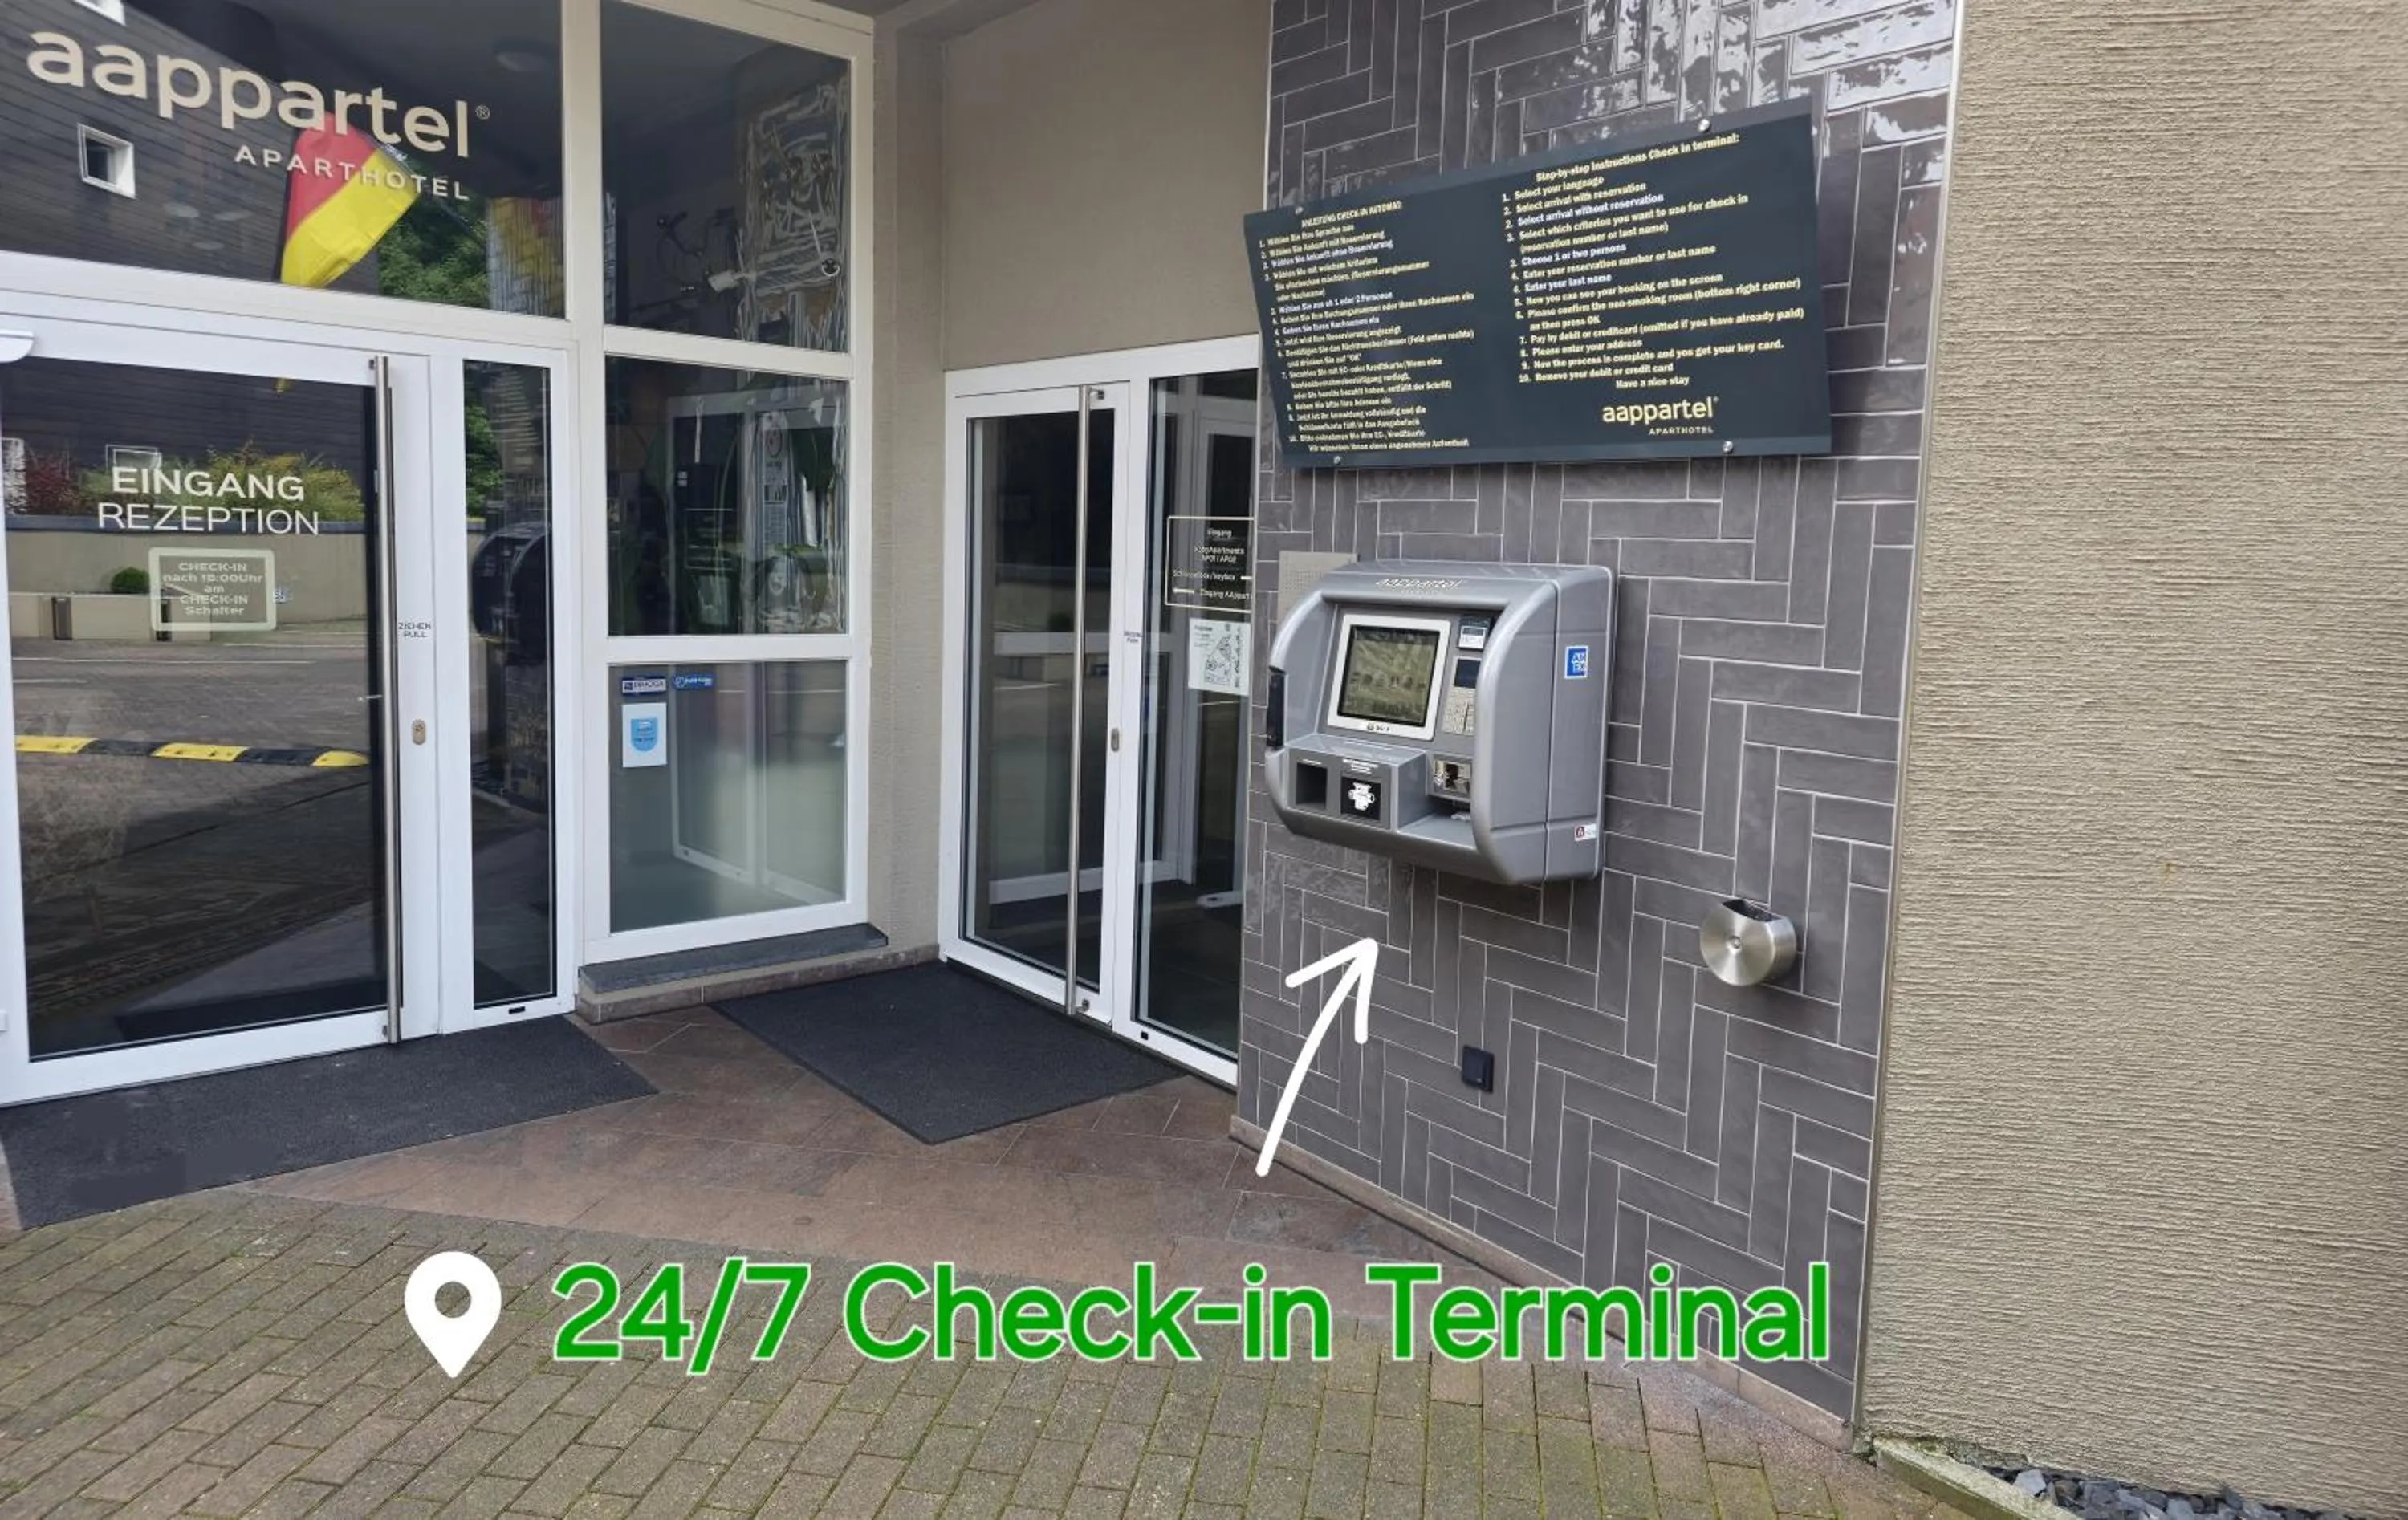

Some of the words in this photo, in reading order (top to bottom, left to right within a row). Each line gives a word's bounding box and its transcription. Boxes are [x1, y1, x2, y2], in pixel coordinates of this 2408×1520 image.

[1536, 165, 1589, 181] Step-by-step
[1648, 145, 1679, 159] Check
[1680, 143, 1690, 152] in
[1691, 132, 1739, 151] terminal:
[234, 144, 470, 201] APARTHOTEL
[1514, 187, 1541, 199] Select
[1542, 184, 1561, 196] your
[1515, 200, 1543, 213] Select
[1544, 194, 1572, 208] arrival
[1572, 192, 1592, 202] with
[1593, 182, 1645, 199] reservation
[1517, 213, 1544, 226] Select
[1545, 208, 1573, 221] arrival
[1574, 201, 1609, 215] without
[1609, 193, 1663, 209] reservation
[1519, 227, 1545, 239] Select
[1546, 222, 1572, 234] which
[1613, 214, 1629, 226] you
[1630, 209, 1653, 221] want
[1655, 208, 1666, 217] to
[1668, 205, 1686, 215] use
[1687, 201, 1703, 212] for
[1704, 195, 1735, 209] check
[1737, 193, 1748, 204] in
[1520, 238, 1571, 254] (reservation
[1572, 233, 1605, 244] number
[1607, 231, 1617, 239] or
[1618, 226, 1637, 238] last
[1638, 221, 1668, 234] name)
[1521, 254, 1552, 265] Choose
[1572, 250, 1588, 258] two
[1589, 243, 1626, 257] persons
[1523, 270, 1544, 278] Enter
[1546, 266, 1565, 277] your
[1566, 259, 1617, 273] reservation
[1618, 254, 1653, 266] number
[1666, 248, 1686, 258] last
[1687, 245, 1715, 256] name
[1524, 282, 1546, 291] Enter
[1548, 280, 1567, 290] your
[1568, 276, 1585, 286] last
[1587, 274, 1612, 284] name
[1526, 296, 1543, 304] Now
[1545, 295, 1560, 304] you
[1561, 292, 1577, 300] can
[1579, 290, 1595, 299] see
[1597, 287, 1616, 298] your
[1617, 282, 1655, 293] booking
[1656, 281, 1669, 289] on
[1670, 278, 1686, 287] the
[1689, 274, 1723, 285] screen
[1527, 308, 1556, 318] Please
[1591, 301, 1606, 310] the
[1667, 292, 1693, 302] room
[1694, 287, 1734, 300] (bottom
[1735, 282, 1760, 295] right
[1762, 278, 1800, 291] corner)
[1530, 335, 1545, 343] Pay
[1547, 333, 1557, 343] by
[1558, 330, 1580, 340] debit
[1680, 319, 1688, 328] if
[1690, 319, 1708, 329] you
[1709, 316, 1734, 326] have
[1735, 311, 1774, 323] already
[1776, 307, 1804, 321] paid)
[1541, 320, 1560, 329] then
[1561, 318, 1586, 328] press
[1587, 315, 1600, 324] OK
[1532, 347, 1560, 356] Please
[1561, 344, 1584, 353] enter
[1585, 343, 1605, 352] your
[1552, 359, 1567, 367] the
[1568, 356, 1601, 367] process
[1613, 351, 1654, 362] complete
[1656, 348, 1674, 358] and
[1675, 349, 1694, 358] you
[1694, 345, 1711, 357] get
[1713, 344, 1735, 356] your
[1737, 343, 1755, 352] key
[1757, 339, 1784, 350] card.
[1568, 371, 1587, 380] your
[1588, 367, 1612, 377] debit
[1624, 364, 1650, 374] credit
[1652, 362, 1673, 372] card
[1615, 380, 1637, 388] Have
[1647, 376, 1668, 386] nice
[1669, 376, 1689, 385] stay
[1649, 426, 1714, 436] APARTHOTEL
[112, 466, 304, 501] EINGANG
[98, 502, 319, 535] REZEPTION
[163, 573, 198, 583] nach
[178, 563, 248, 572] CHECK-IN
[179, 595, 249, 604] CHECK-IN
[205, 584, 225, 594] am
[184, 606, 245, 616] Schalter
